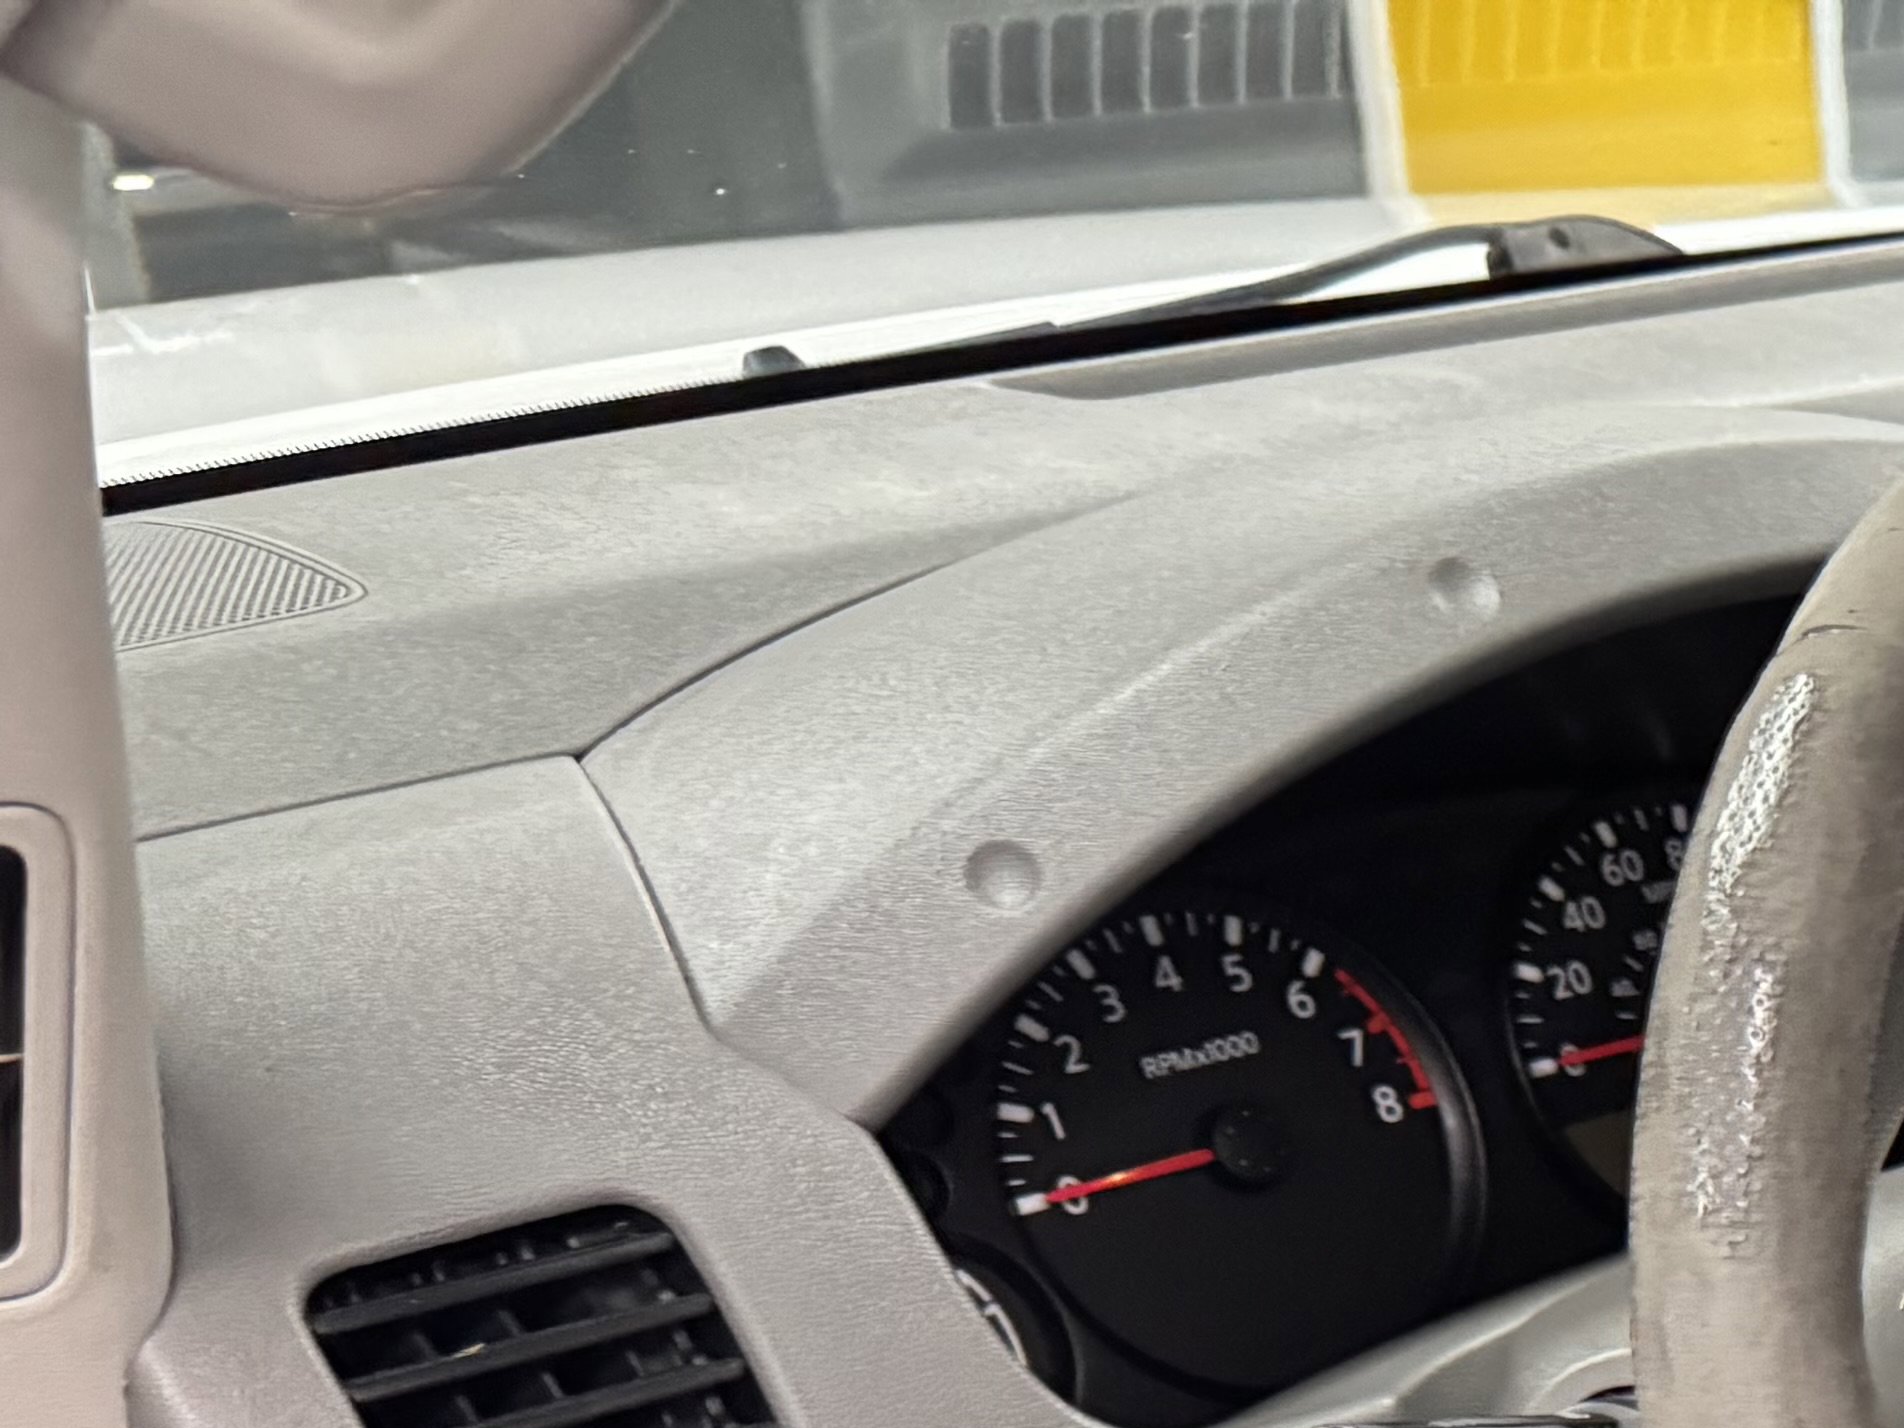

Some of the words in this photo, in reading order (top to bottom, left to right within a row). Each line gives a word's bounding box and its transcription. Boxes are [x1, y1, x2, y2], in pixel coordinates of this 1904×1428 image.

[1601, 848, 1645, 887] 60
[1562, 896, 1606, 932] 40
[1156, 957, 1182, 991] 4
[1222, 953, 1252, 993] 5
[1546, 959, 1593, 1000] 20
[1096, 984, 1126, 1022] 3
[1287, 980, 1315, 1019] 6
[1055, 1034, 1089, 1074] 2
[1338, 1027, 1364, 1067] 7
[1041, 1102, 1066, 1139] 1
[1372, 1085, 1404, 1123] 8
[1059, 1174, 1089, 1216] 0
